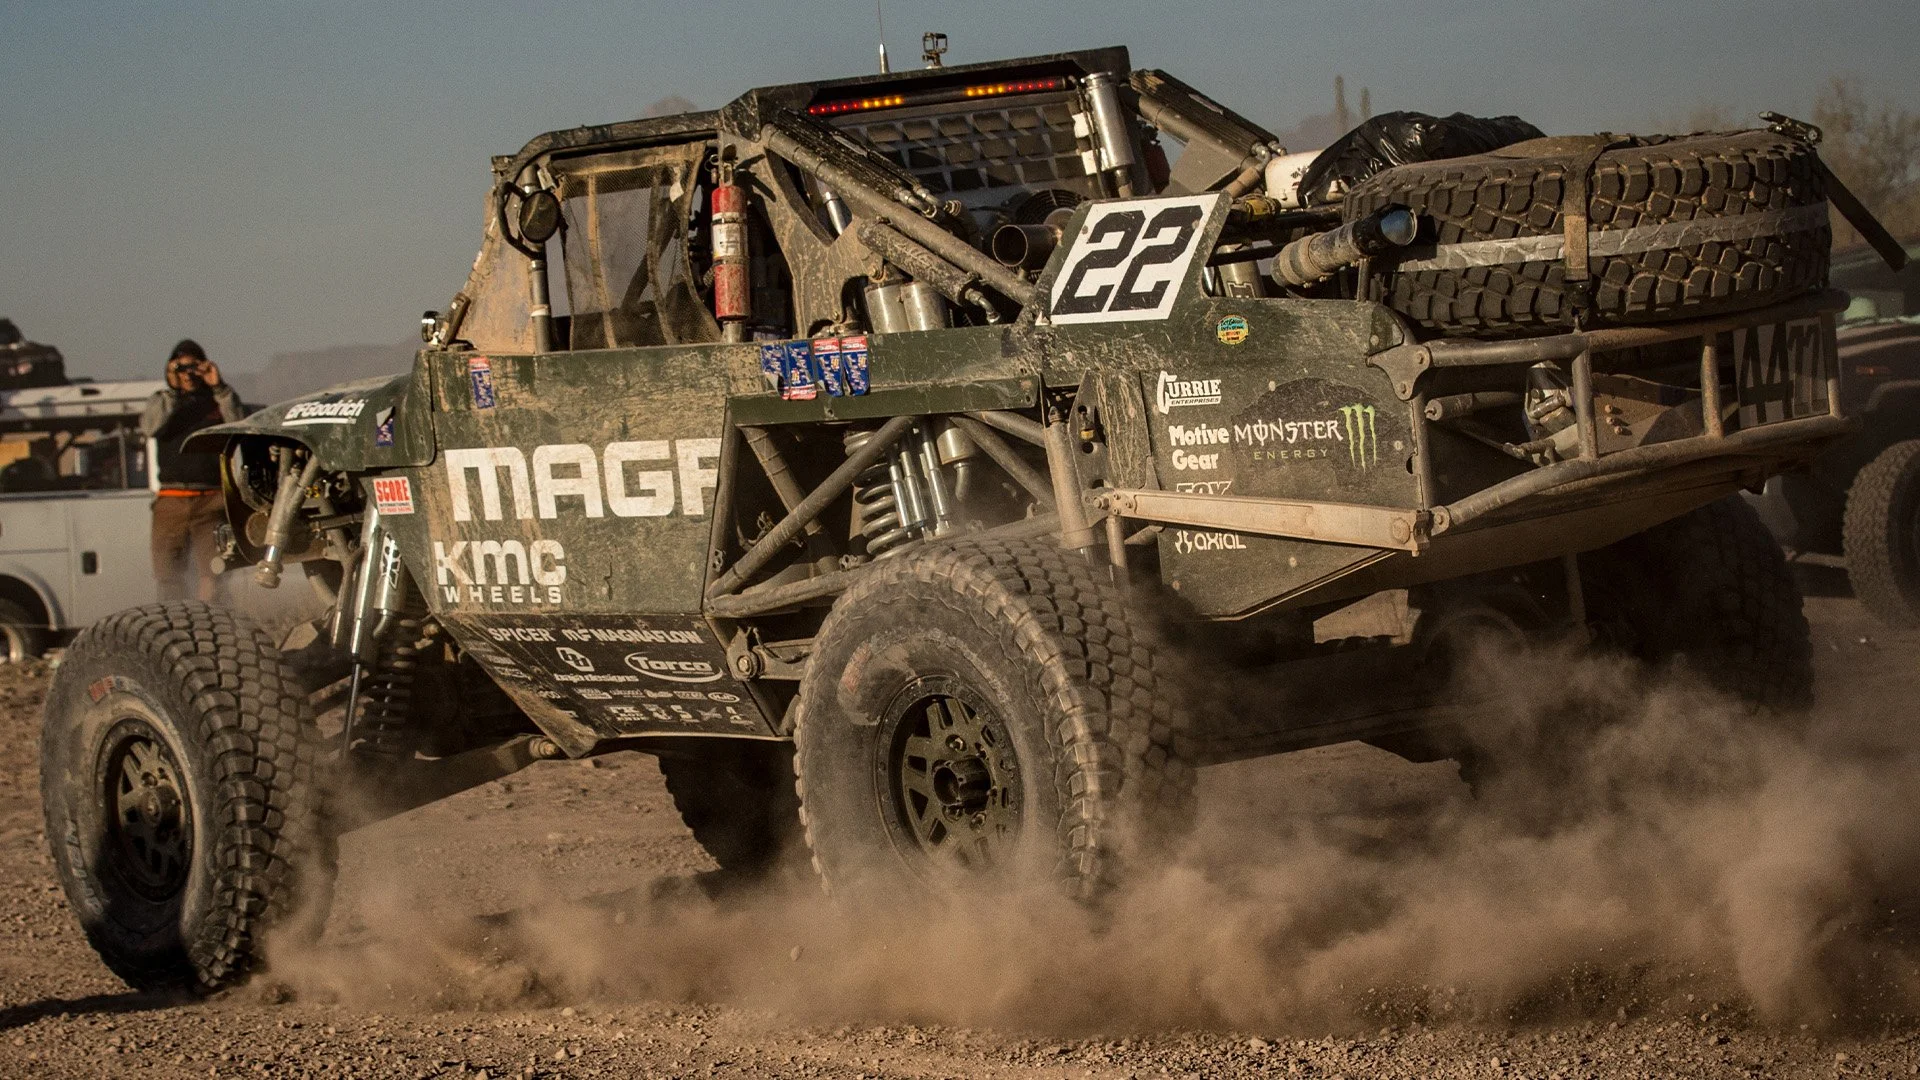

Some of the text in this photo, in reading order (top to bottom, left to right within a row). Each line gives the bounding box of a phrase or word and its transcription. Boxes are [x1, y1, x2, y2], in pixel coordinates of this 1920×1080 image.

[1051, 205, 1203, 315] 22
[1157, 370, 1222, 414] CURRIE
[1170, 397, 1219, 405] ENTERPRISES
[284, 399, 365, 420] BFGoodrich
[1168, 423, 1230, 446] Motive
[1172, 449, 1219, 470] Gear
[1253, 449, 1328, 460] ENERGY
[376, 479, 410, 502] SCORE
[444, 586, 562, 604] WHEELS
[487, 627, 557, 642] SPICER
[589, 629, 704, 644] MAGNAFLOW
[636, 656, 713, 671] Torco
